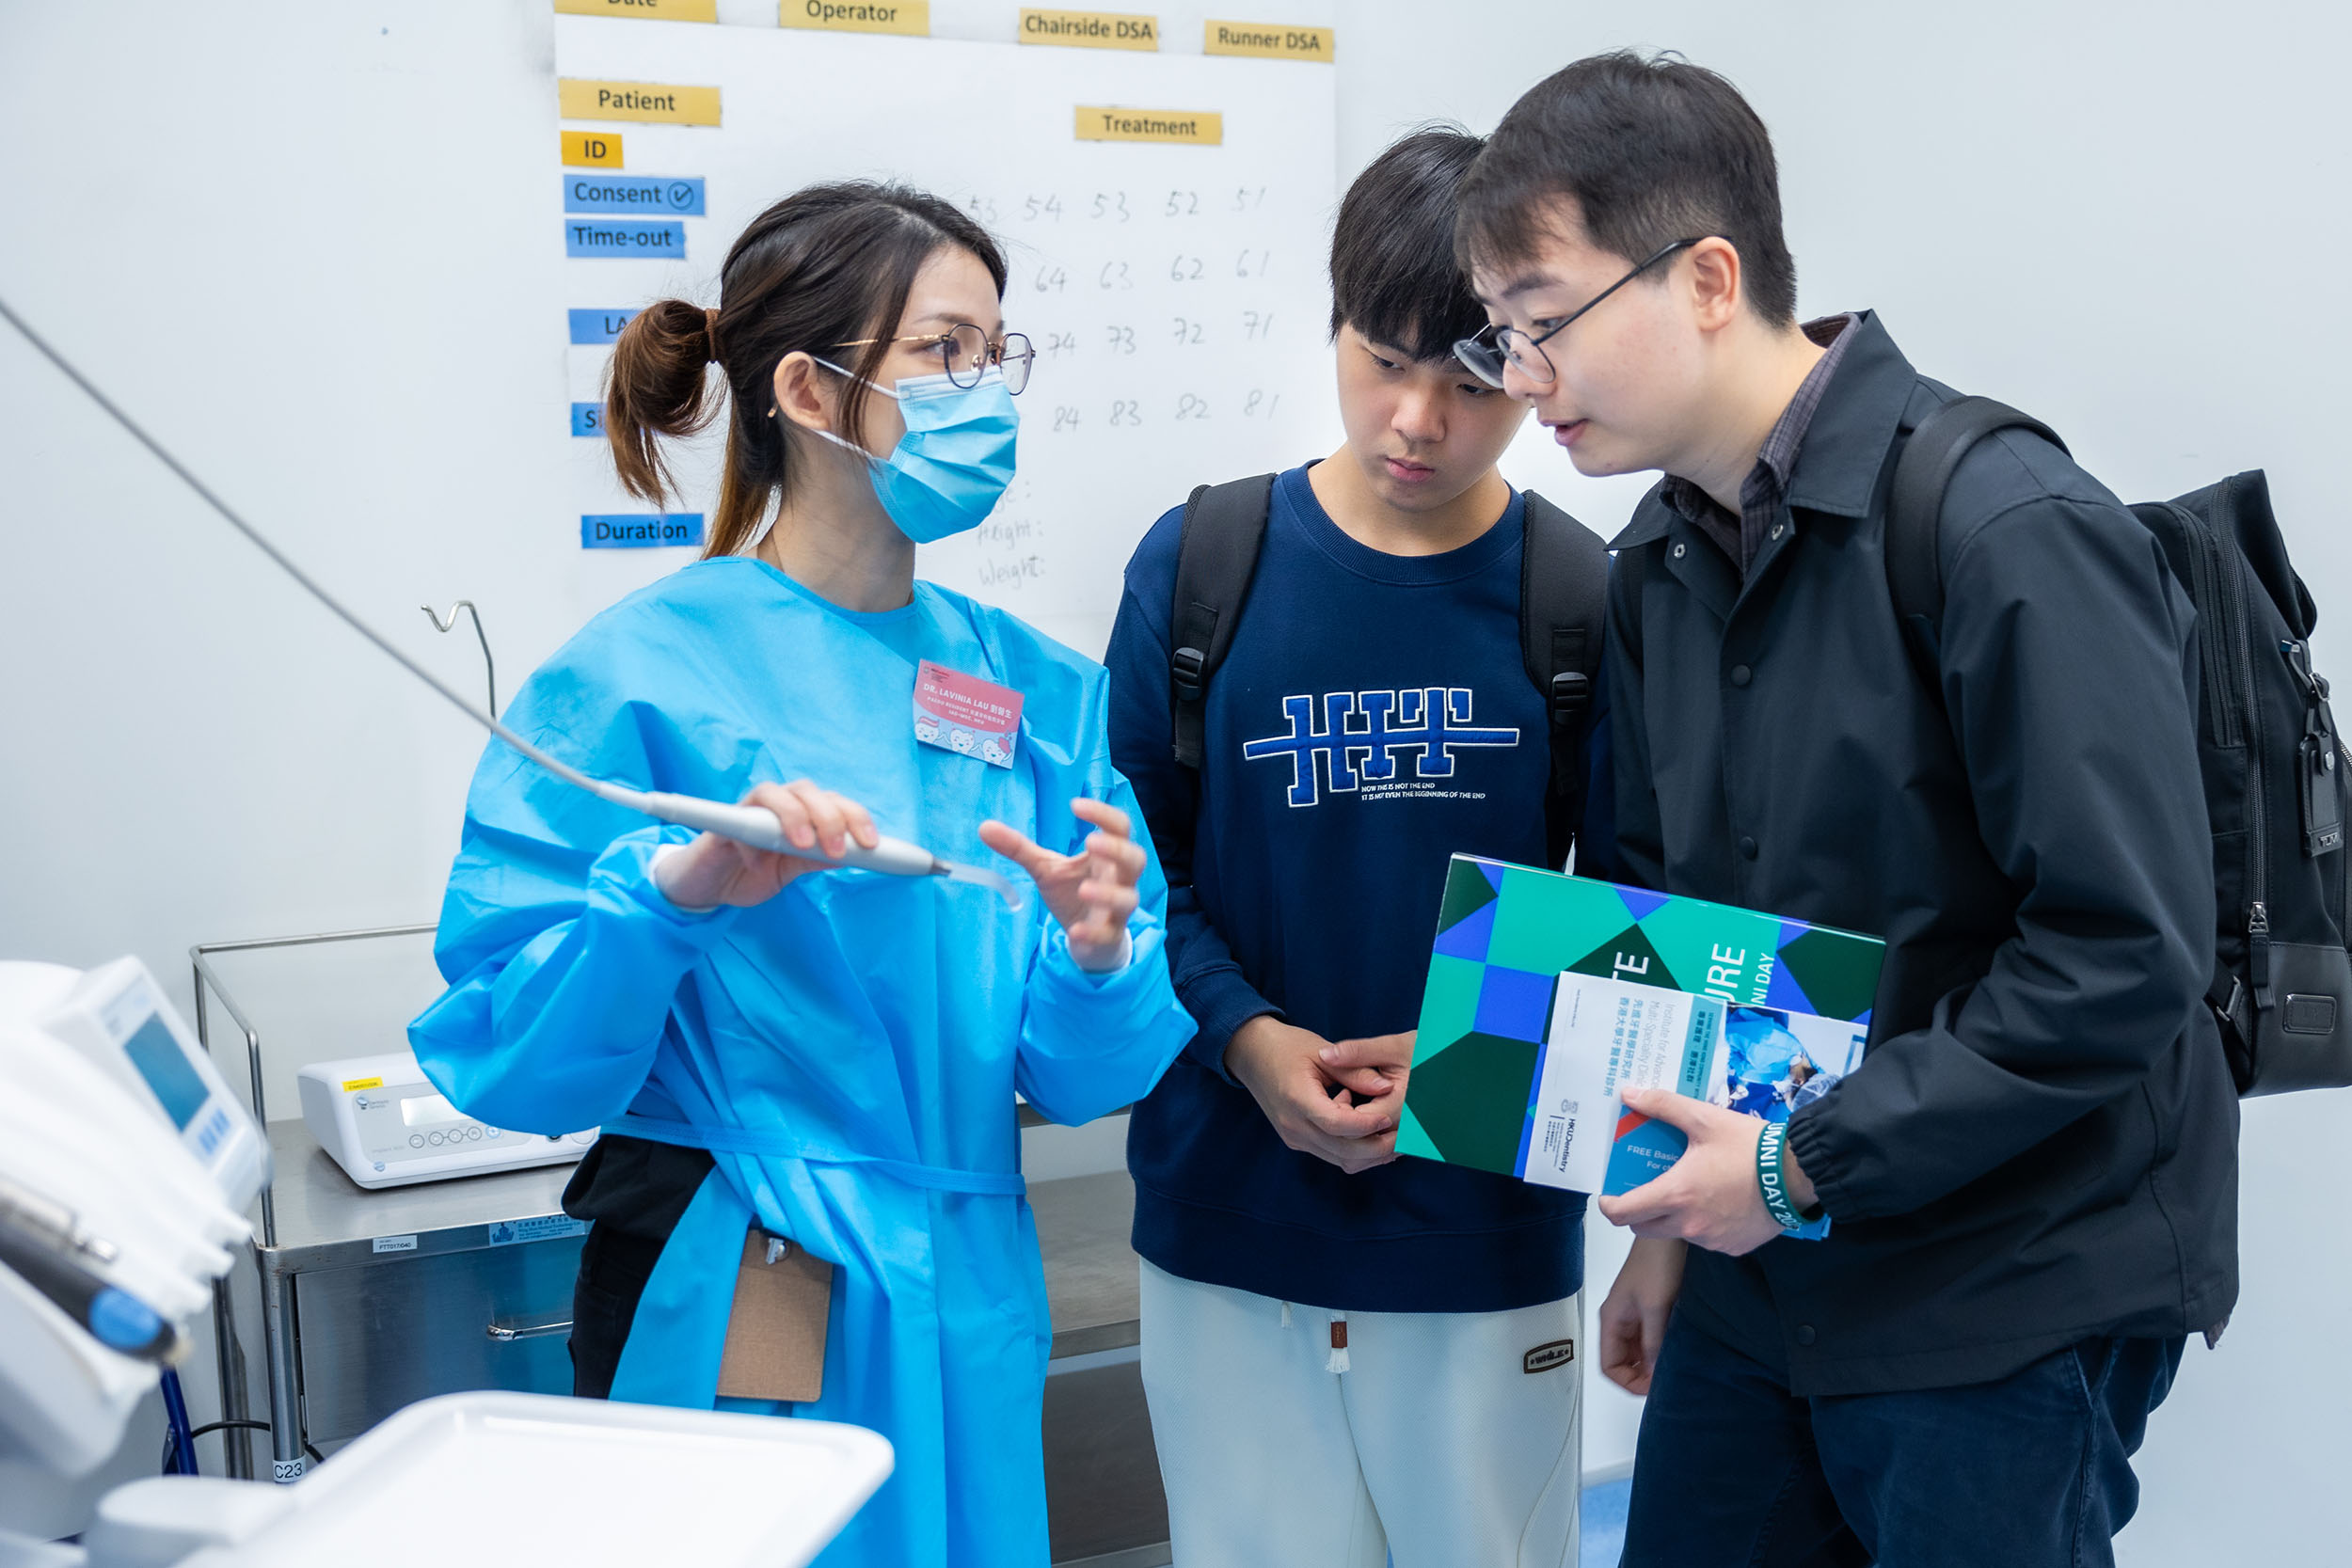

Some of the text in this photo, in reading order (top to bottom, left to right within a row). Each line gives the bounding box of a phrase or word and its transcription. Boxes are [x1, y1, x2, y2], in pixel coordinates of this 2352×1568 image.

[806, 0, 898, 23] Operator
[1025, 15, 1153, 40] Chairside DSA
[1218, 27, 1321, 51] Runner DSA
[598, 89, 675, 112] Patient
[1103, 113, 1198, 135] Treatment
[583, 140, 607, 159] ID
[574, 182, 662, 204] Consent
[1024, 194, 1064, 224] 54
[1090, 191, 1131, 223] 53
[1164, 190, 1200, 217] 52
[1231, 186, 1265, 213] 51
[574, 227, 672, 246] Time-out
[1035, 249, 1270, 293] 64 63 62 61
[1047, 310, 1274, 359] 74 73 72 71
[1053, 388, 1279, 433] 84 83 82 81
[595, 521, 688, 540] Duration
[923, 683, 937, 694] DR.
[939, 688, 971, 705] LAVINIA
[974, 700, 989, 710] LAU
[1755, 952, 1775, 985] DAY
[1660, 1003, 1676, 1038] Institute
[1559, 1117, 1576, 1173] HKUDentistry
[1627, 1145, 1652, 1157] FREE
[1646, 1161, 1661, 1169] For
[1761, 1172, 1787, 1209] DAY
[274, 1463, 303, 1479] C23
